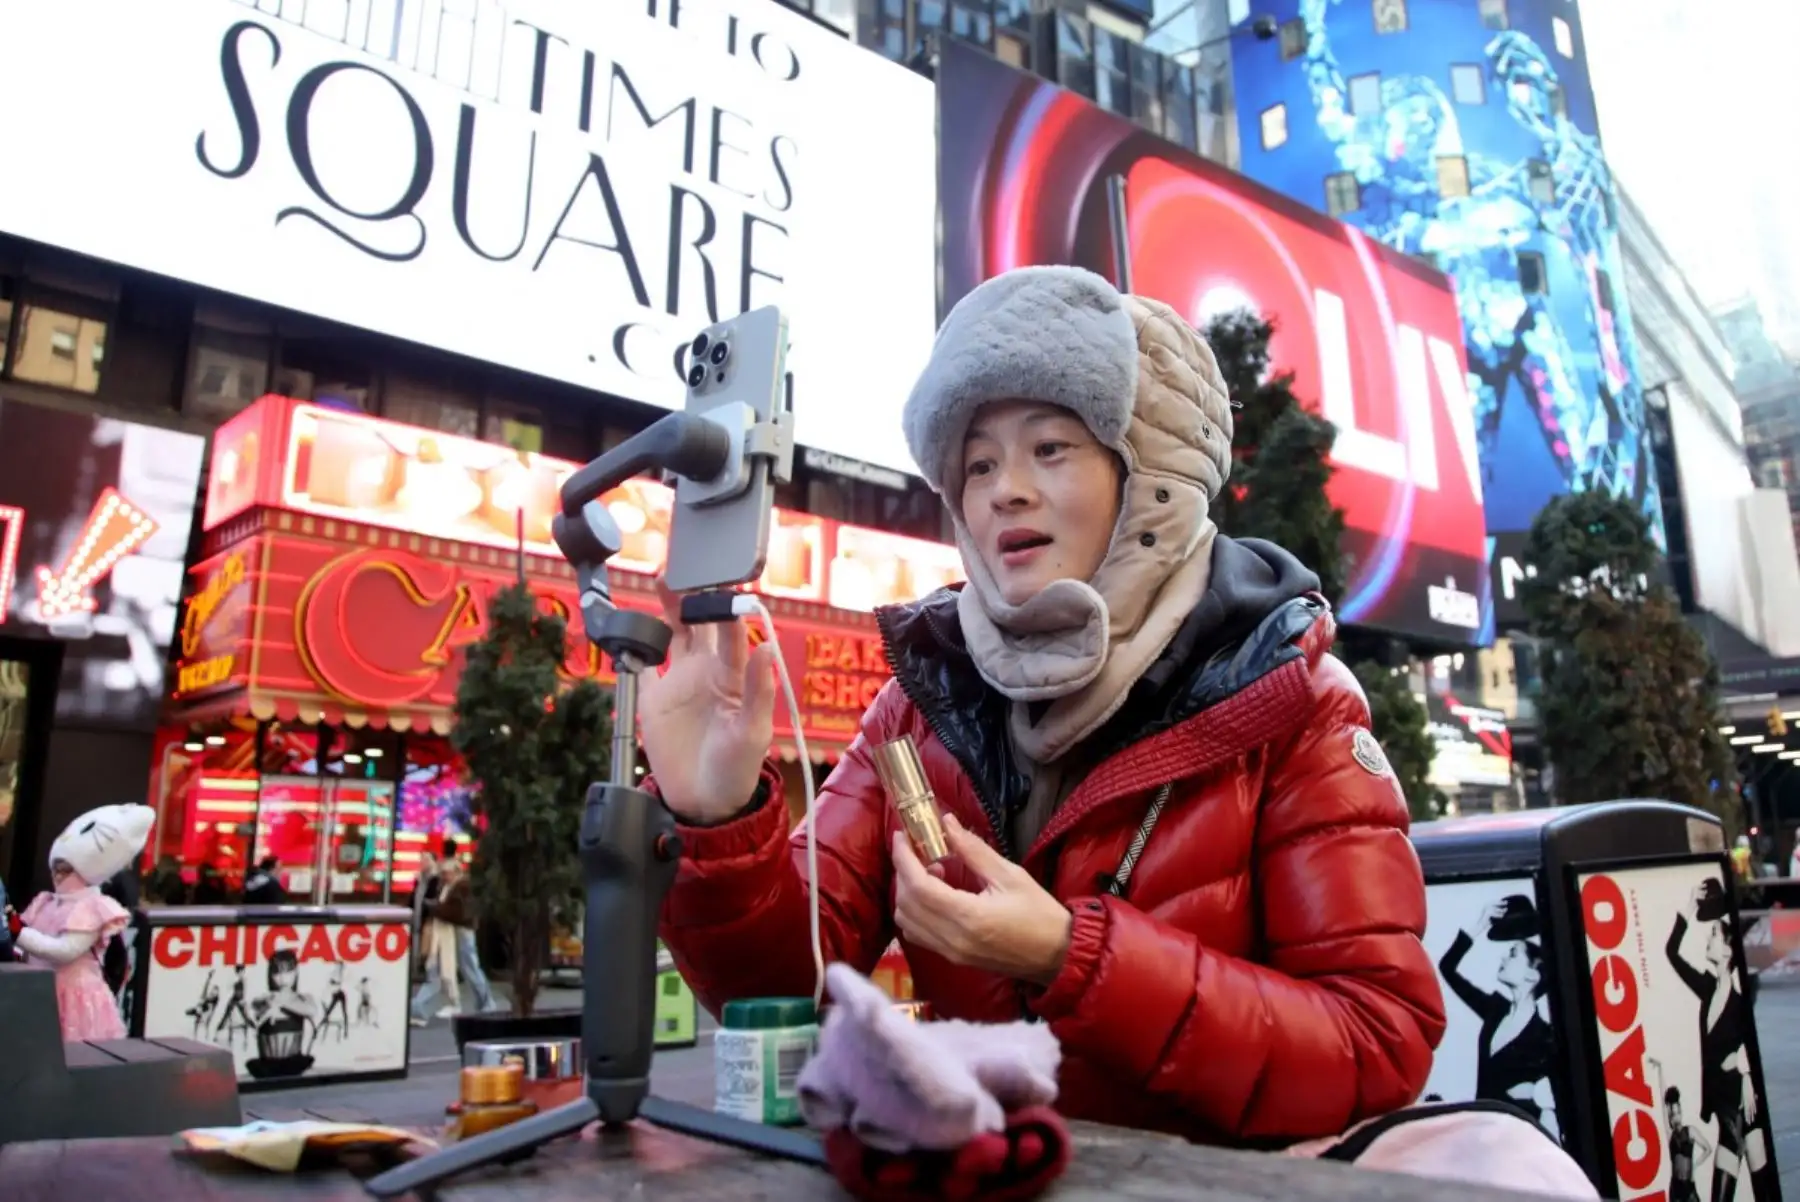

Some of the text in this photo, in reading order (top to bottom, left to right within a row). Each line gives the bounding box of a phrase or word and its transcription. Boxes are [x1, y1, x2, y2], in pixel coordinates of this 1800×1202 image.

[514, 20, 798, 212] TIMES
[195, 21, 792, 323] SQUARE
[806, 634, 893, 673] BAK
[803, 671, 882, 710] SHO
[154, 923, 410, 968] CHICAGO
